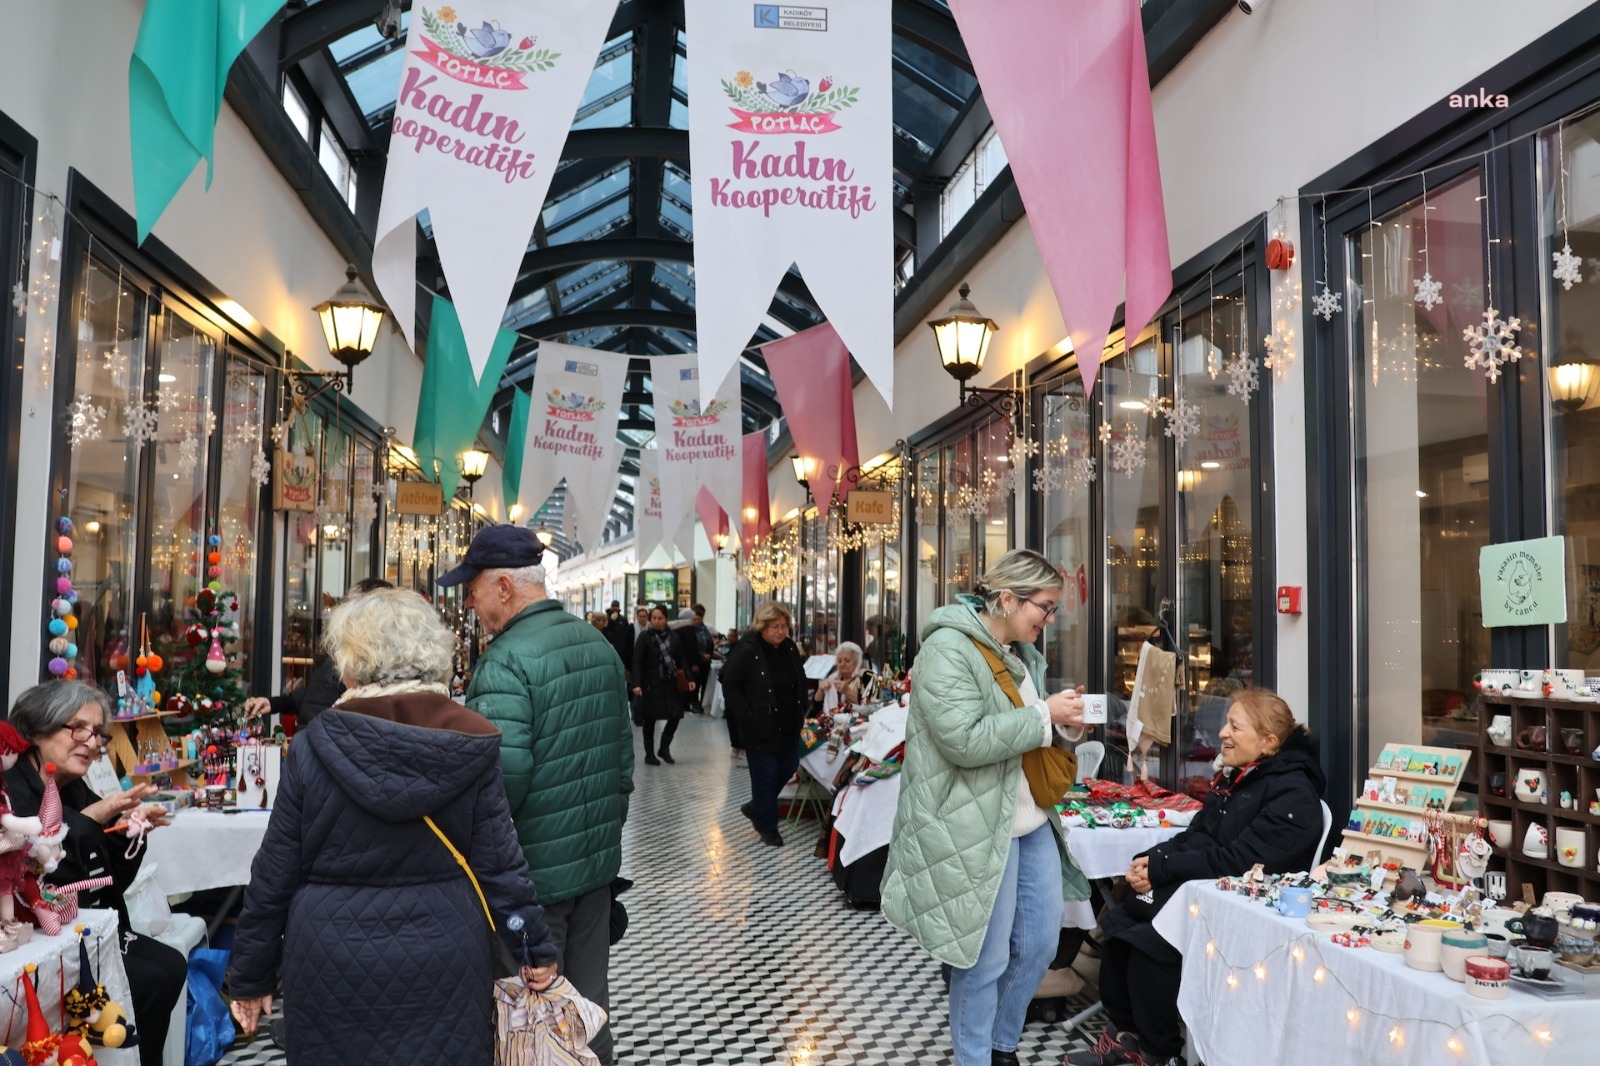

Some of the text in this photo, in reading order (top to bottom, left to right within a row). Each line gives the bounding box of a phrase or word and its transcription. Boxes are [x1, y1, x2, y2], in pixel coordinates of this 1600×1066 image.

[783, 9, 813, 17] KADIKÖY
[783, 20, 822, 29] BELEDİYESİ
[436, 52, 512, 88] POTLAÇ
[400, 67, 526, 144] Kadın
[750, 116, 825, 134] POTLAÇ
[391, 115, 536, 184] ooperatifi
[731, 140, 855, 182] Kadın
[709, 177, 876, 220] Kooperatifi
[545, 419, 597, 444] Kadın
[674, 428, 727, 448] Kadın
[534, 435, 605, 461] Kooperatifi
[665, 445, 737, 465] Kooperatifi
[401, 491, 438, 505] Atölye
[856, 500, 884, 514] Kafe
[1520, 551, 1542, 582] memeler
